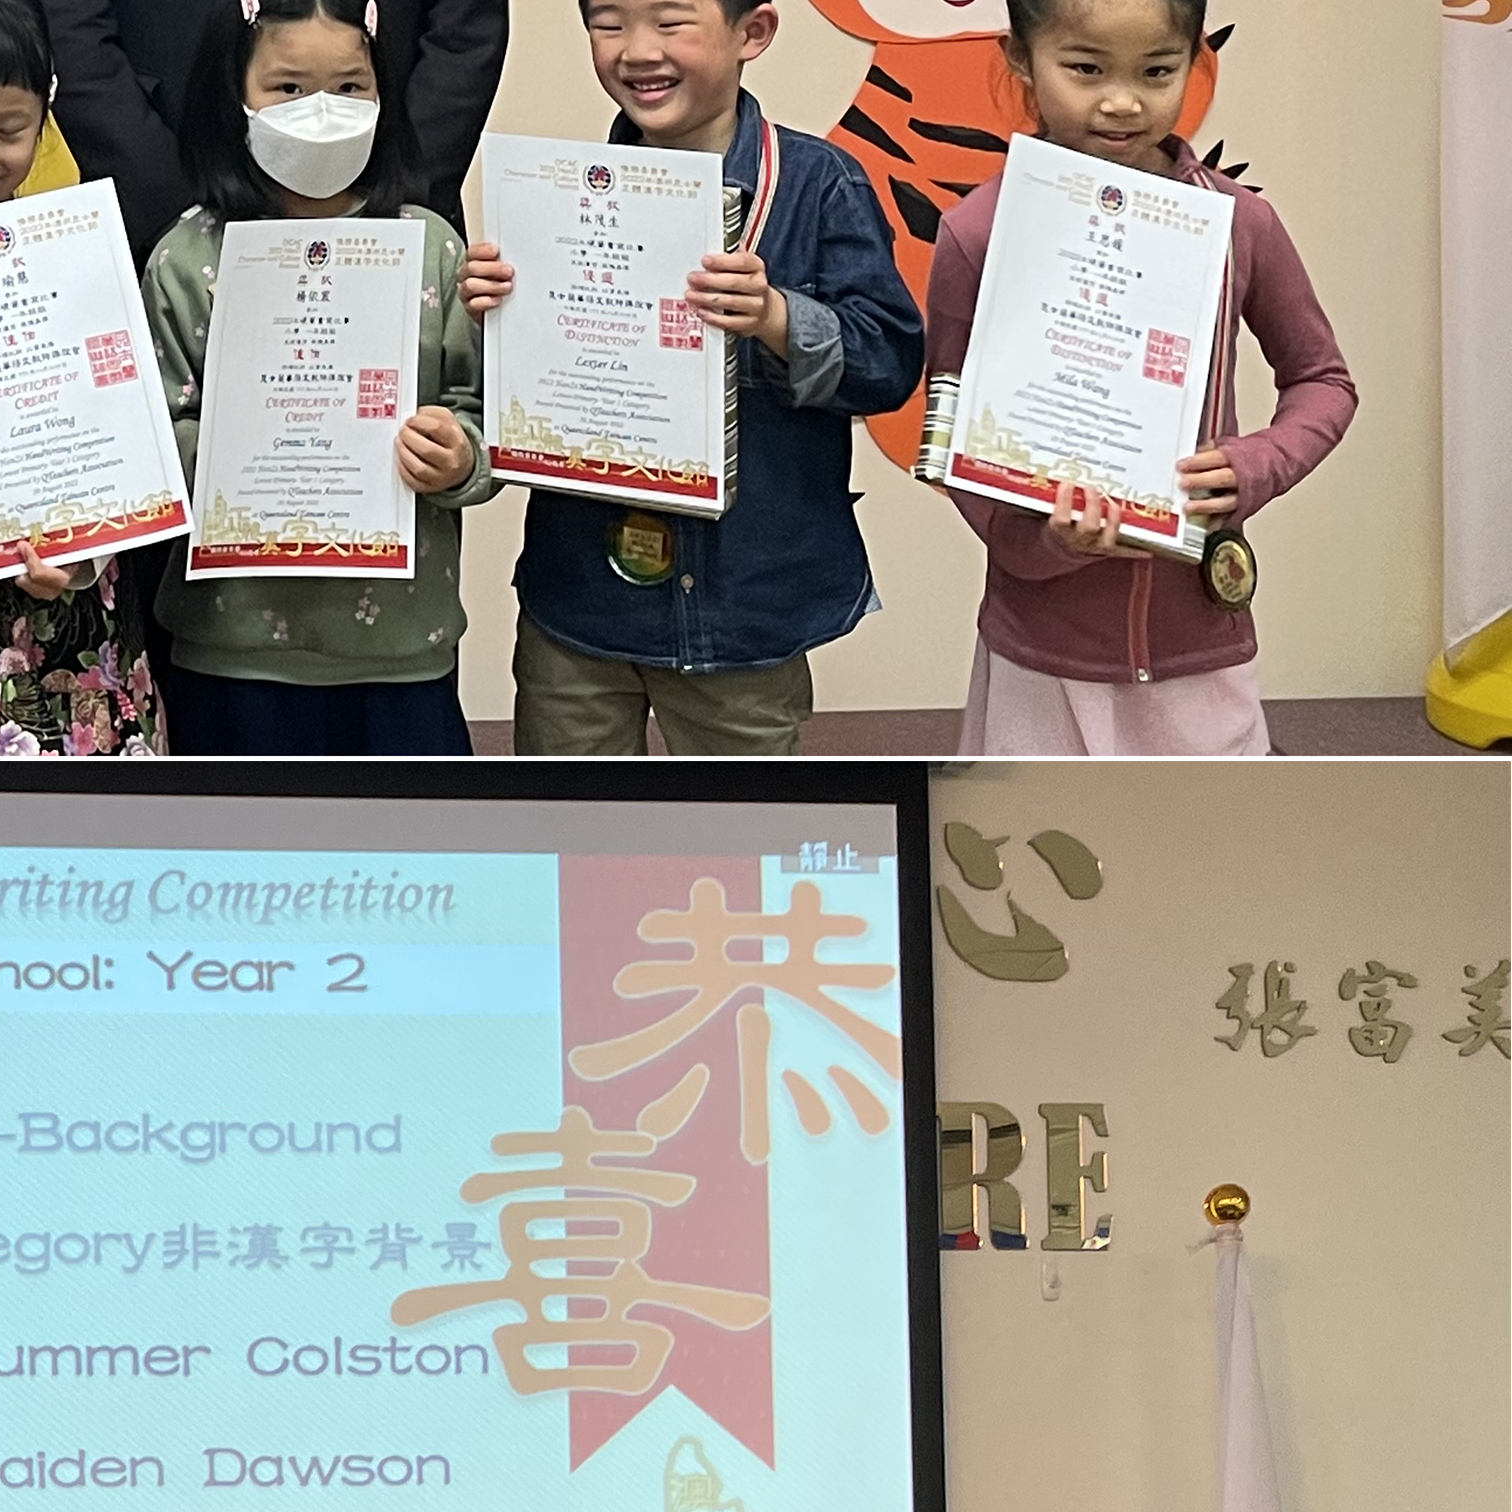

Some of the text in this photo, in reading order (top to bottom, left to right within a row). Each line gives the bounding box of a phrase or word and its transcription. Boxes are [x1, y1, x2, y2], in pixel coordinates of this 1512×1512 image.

[147, 868, 458, 922] Competition
[148, 950, 294, 993] Year
[325, 955, 368, 993] 2
[247, 1337, 490, 1378] Colston
[203, 1448, 452, 1490] Dawson
